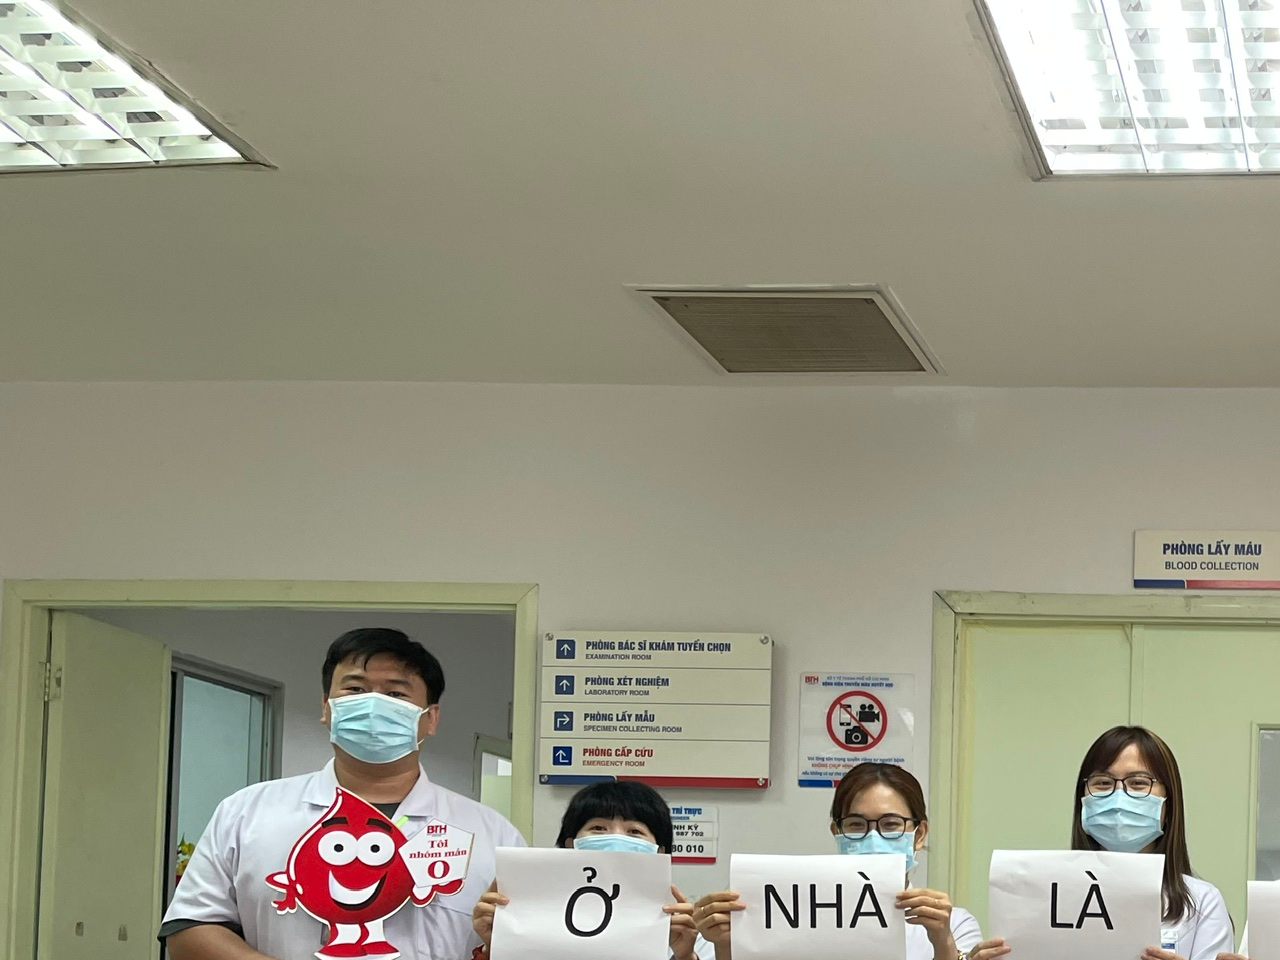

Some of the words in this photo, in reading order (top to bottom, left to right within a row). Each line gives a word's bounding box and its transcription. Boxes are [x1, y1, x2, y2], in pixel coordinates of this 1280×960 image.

[1162, 540, 1204, 555] PHÒNG
[1207, 539, 1231, 556] LẤY
[1234, 541, 1262, 556] MÁU
[1164, 561, 1198, 570] BLOOD
[1200, 561, 1259, 571] COLLECTION
[585, 639, 616, 651] PHÒNG
[618, 640, 636, 651] BÁC
[638, 640, 647, 651] SĨ
[648, 640, 675, 652] KHÁM
[677, 638, 705, 652] TUYỂN
[707, 642, 731, 654] CHỌN
[584, 676, 614, 687] PHÒNG
[617, 676, 633, 687] XÉT
[636, 677, 670, 690] NGHIỆM
[584, 712, 614, 722] PHÒNG
[616, 711, 632, 722] LẤY
[582, 746, 612, 757] PHÒNG
[614, 746, 632, 757] CẤP
[635, 748, 654, 758] CỨU
[428, 825, 447, 834] BTH
[428, 839, 448, 848] Tôi
[444, 848, 466, 857] máu
[428, 860, 450, 879] O
[564, 867, 620, 938] Ở
[764, 871, 888, 929] NHÀ
[1050, 871, 1114, 930] LÀ
